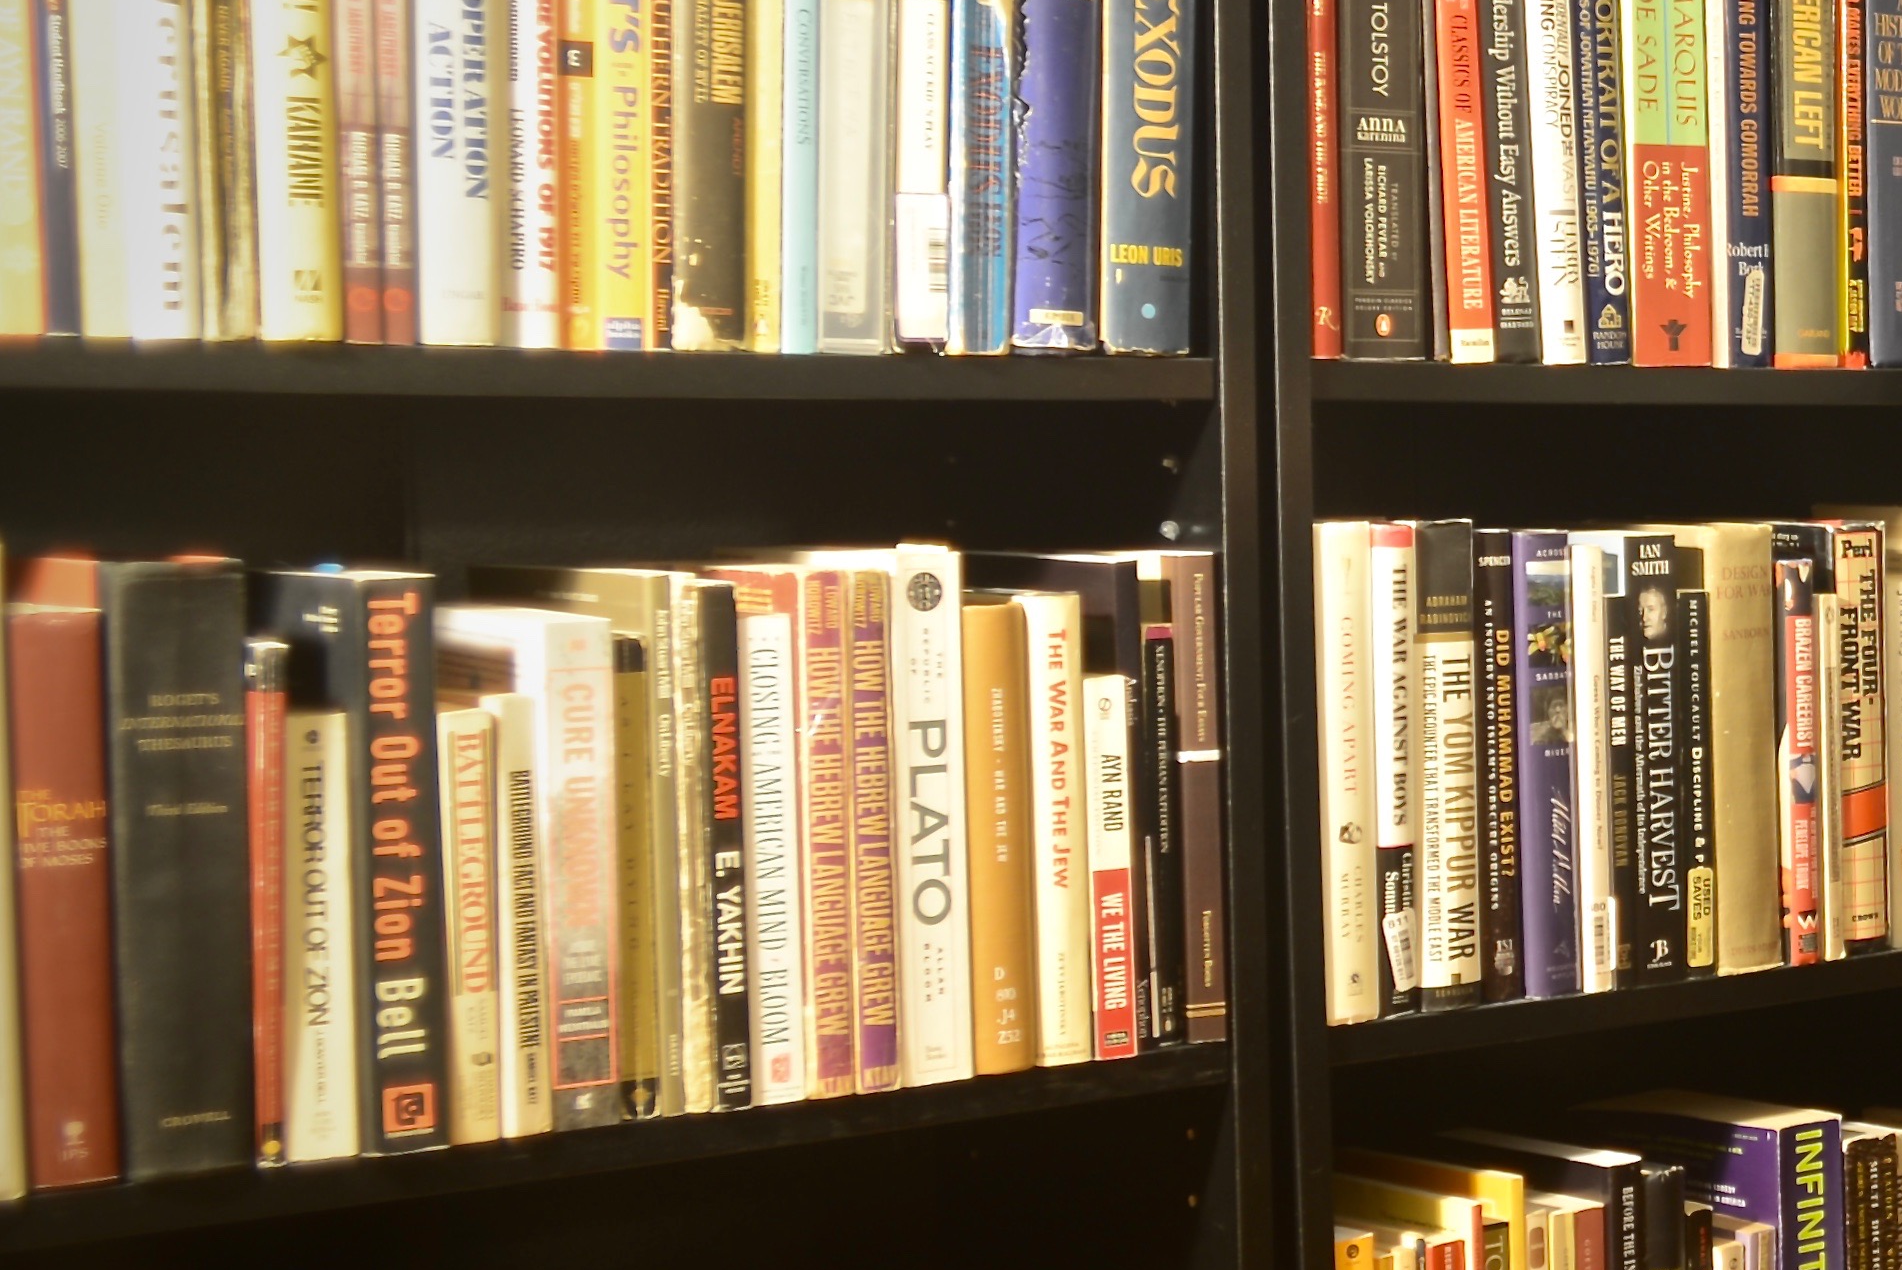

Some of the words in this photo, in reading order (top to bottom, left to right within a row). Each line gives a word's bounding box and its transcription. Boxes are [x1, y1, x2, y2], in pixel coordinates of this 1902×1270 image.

[1371, 2, 1389, 97] TOLSTOY
[1637, 35, 1657, 113] SADE
[286, 95, 323, 208] KAHANE
[1794, 91, 1823, 150] LEFT
[1110, 244, 1148, 266] LEON
[1152, 246, 1182, 268] URIS
[1632, 560, 1670, 575] SMITH
[1639, 543, 1661, 559] IAN
[368, 593, 419, 720] Terror
[1442, 653, 1471, 703] THE
[1644, 646, 1675, 761] BITTER
[372, 736, 419, 804] Out
[710, 678, 738, 821] ELNAKAM
[1443, 710, 1473, 774] YOM
[372, 820, 420, 858] of
[909, 719, 952, 925] PLATO
[1444, 781, 1476, 893] KIPPUR
[1650, 770, 1680, 911] HARVEST
[374, 877, 422, 962] Zion
[1100, 893, 1123, 916] WE
[1100, 922, 1123, 952] THE
[1449, 902, 1476, 961] WAR
[1100, 958, 1126, 1010] LIVING
[376, 978, 427, 1059] Bell
